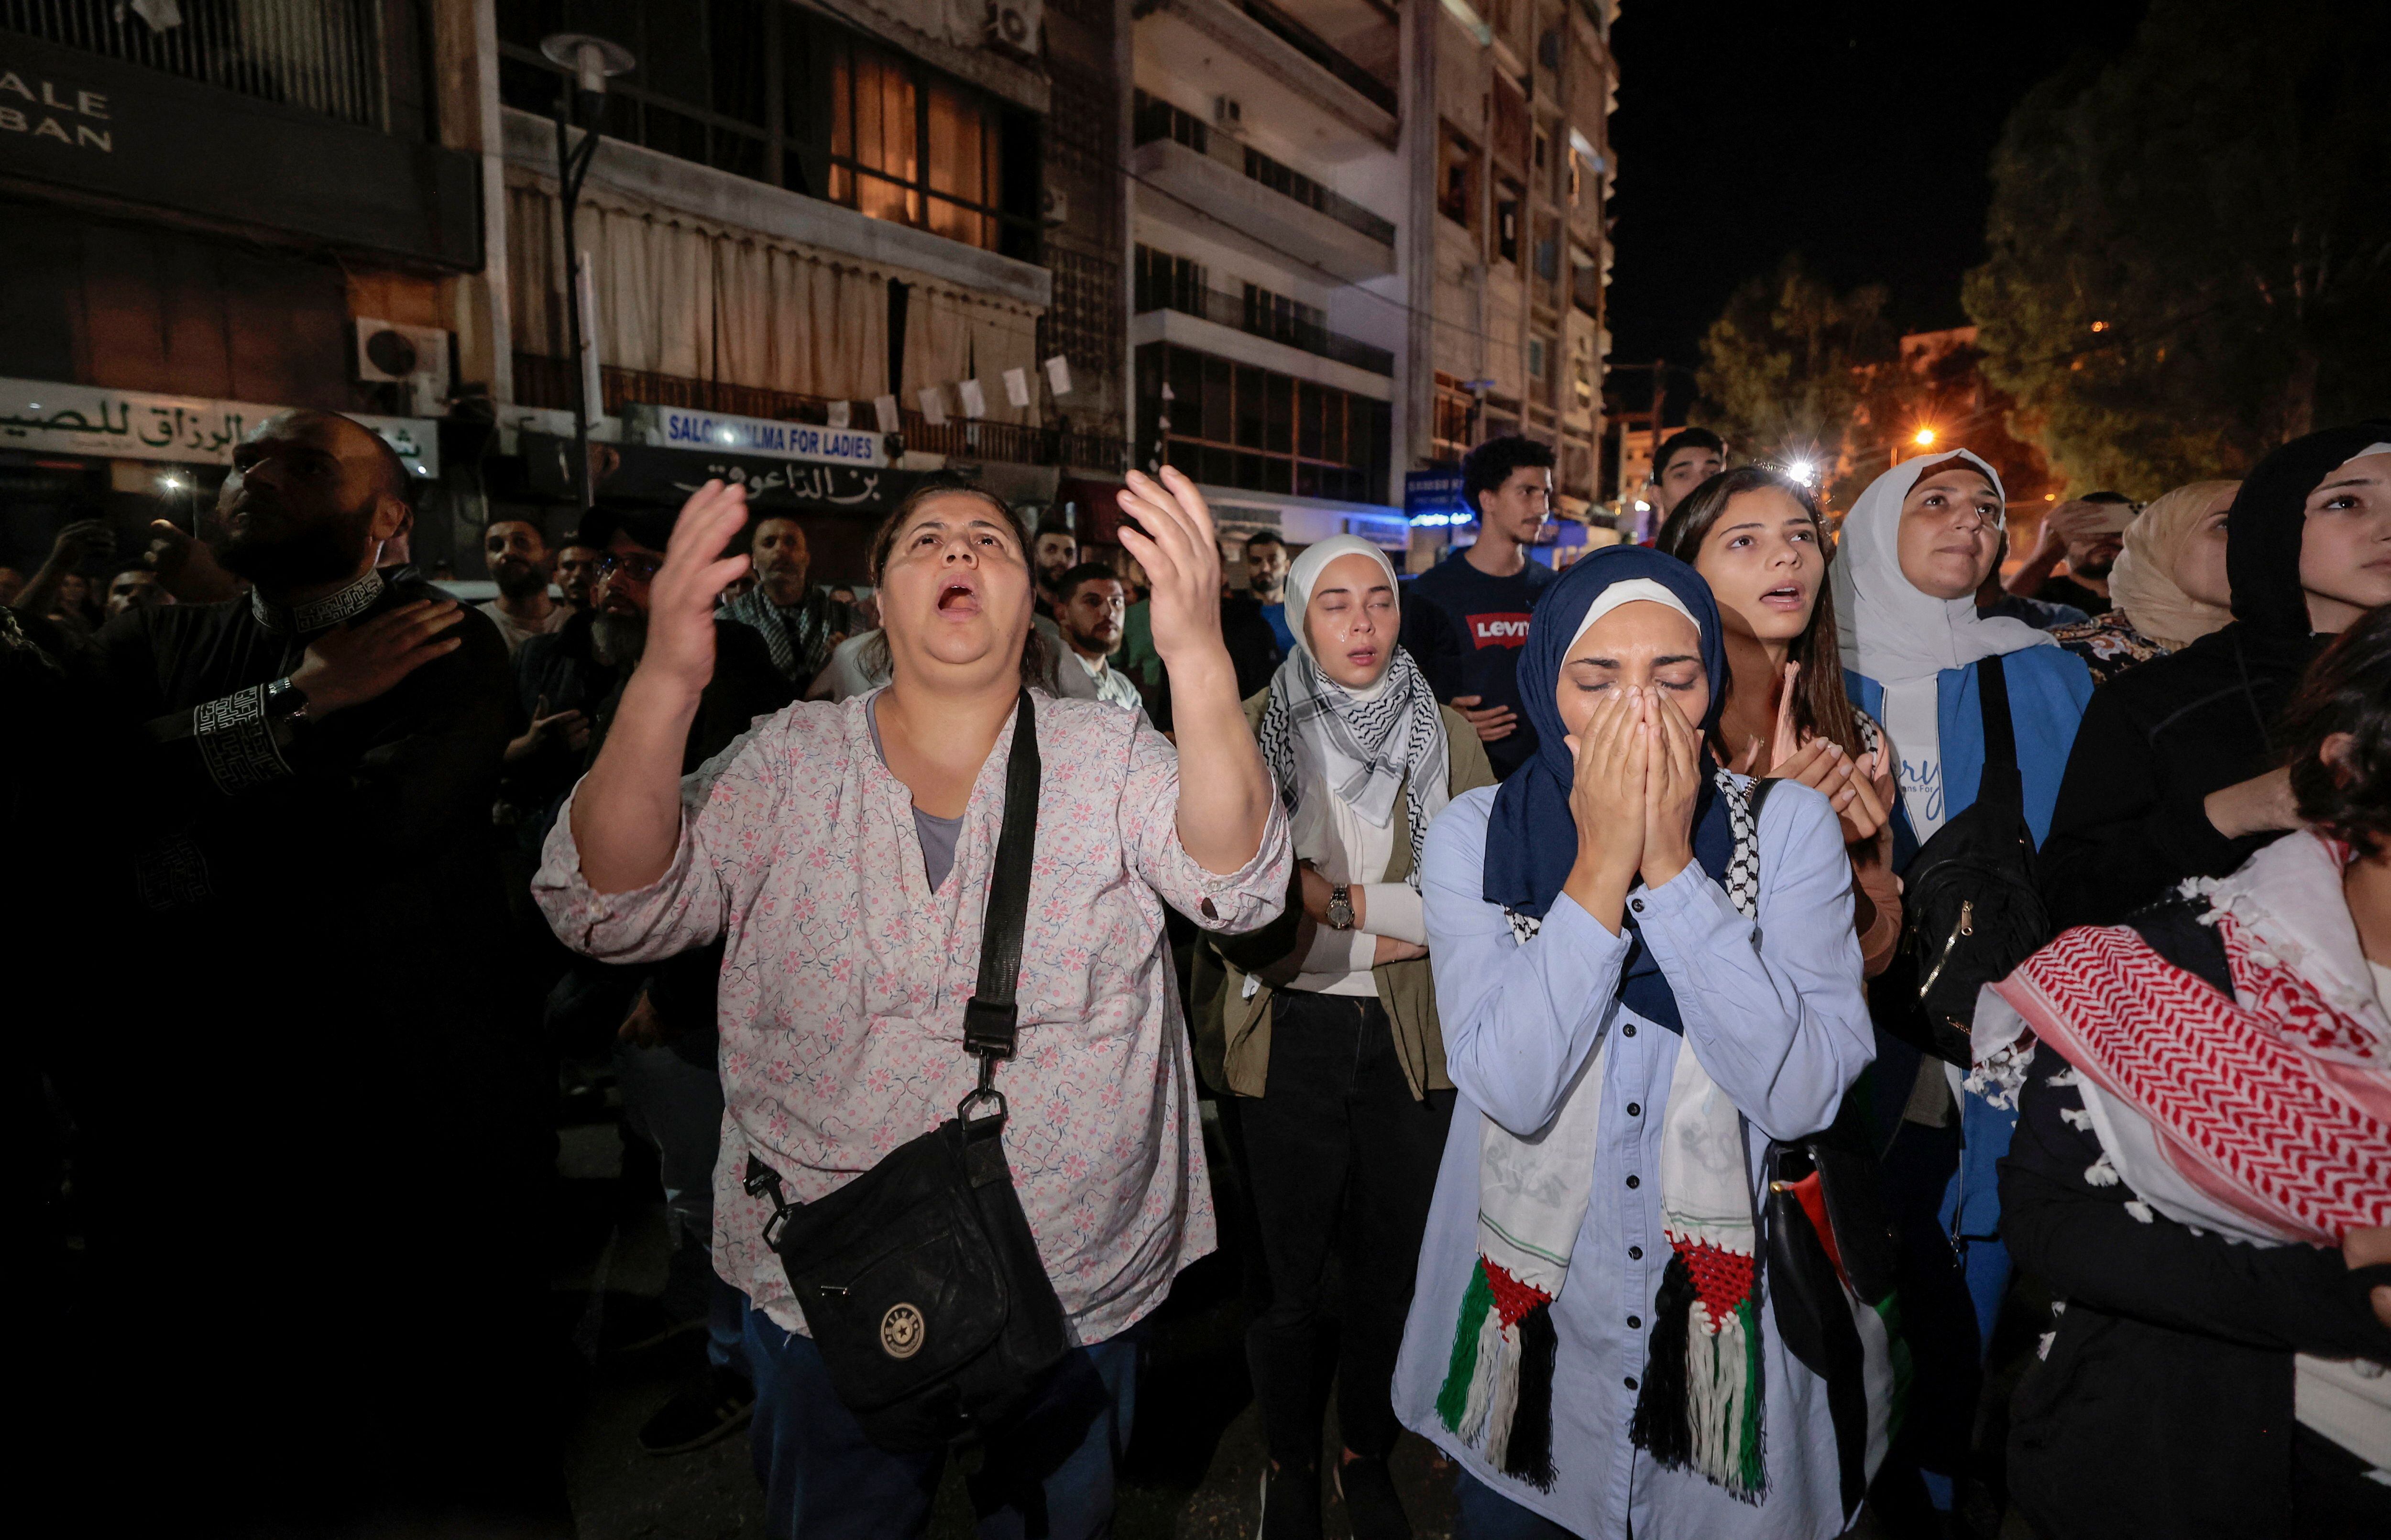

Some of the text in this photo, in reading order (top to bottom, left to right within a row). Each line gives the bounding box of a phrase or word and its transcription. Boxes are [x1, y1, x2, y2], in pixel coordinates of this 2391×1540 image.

[669, 414, 725, 445] SALO
[789, 428, 818, 453] FOR
[823, 433, 872, 459] LADIES
[1898, 759, 1942, 821] ry
